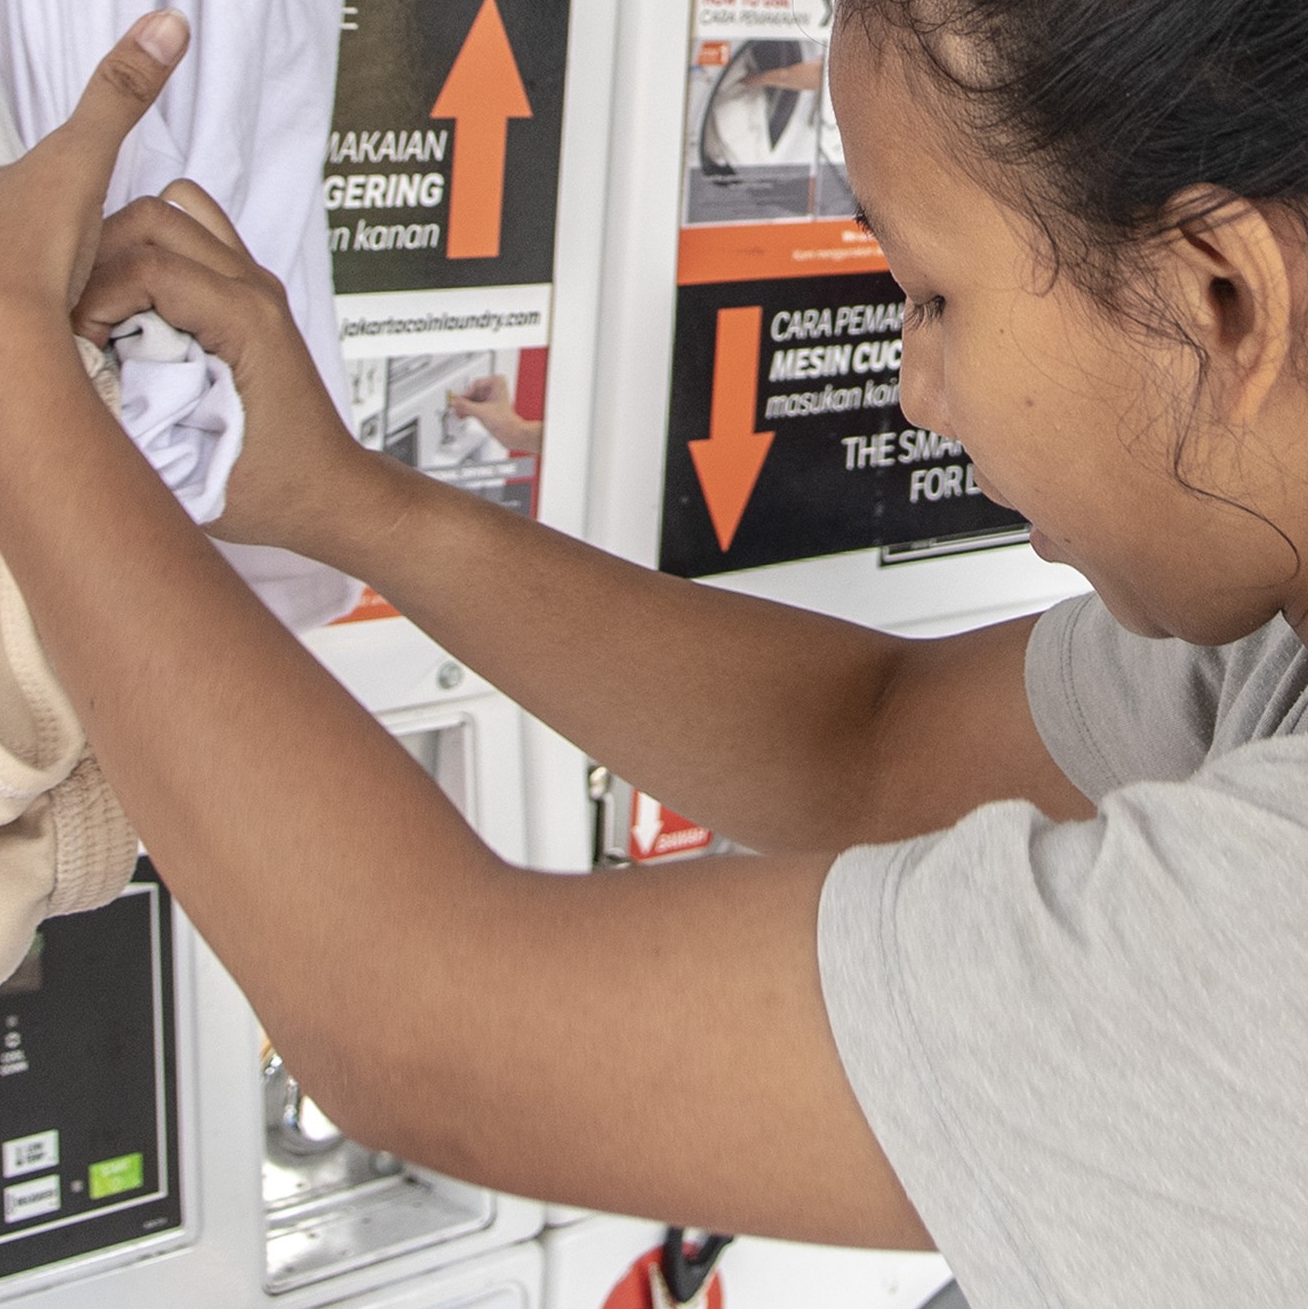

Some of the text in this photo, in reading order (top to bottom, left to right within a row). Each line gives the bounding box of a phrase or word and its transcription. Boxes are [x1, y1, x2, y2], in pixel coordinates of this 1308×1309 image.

[323, 173, 445, 209] GERING
[353, 218, 441, 252] kanan
[339, 309, 541, 342] jakartacoinlaundry.com
[770, 308, 833, 342] CARA
[769, 338, 903, 382] MESIN CUC
[764, 383, 863, 420] masukan
[841, 431, 897, 470] THE
[909, 464, 964, 504] FOR
